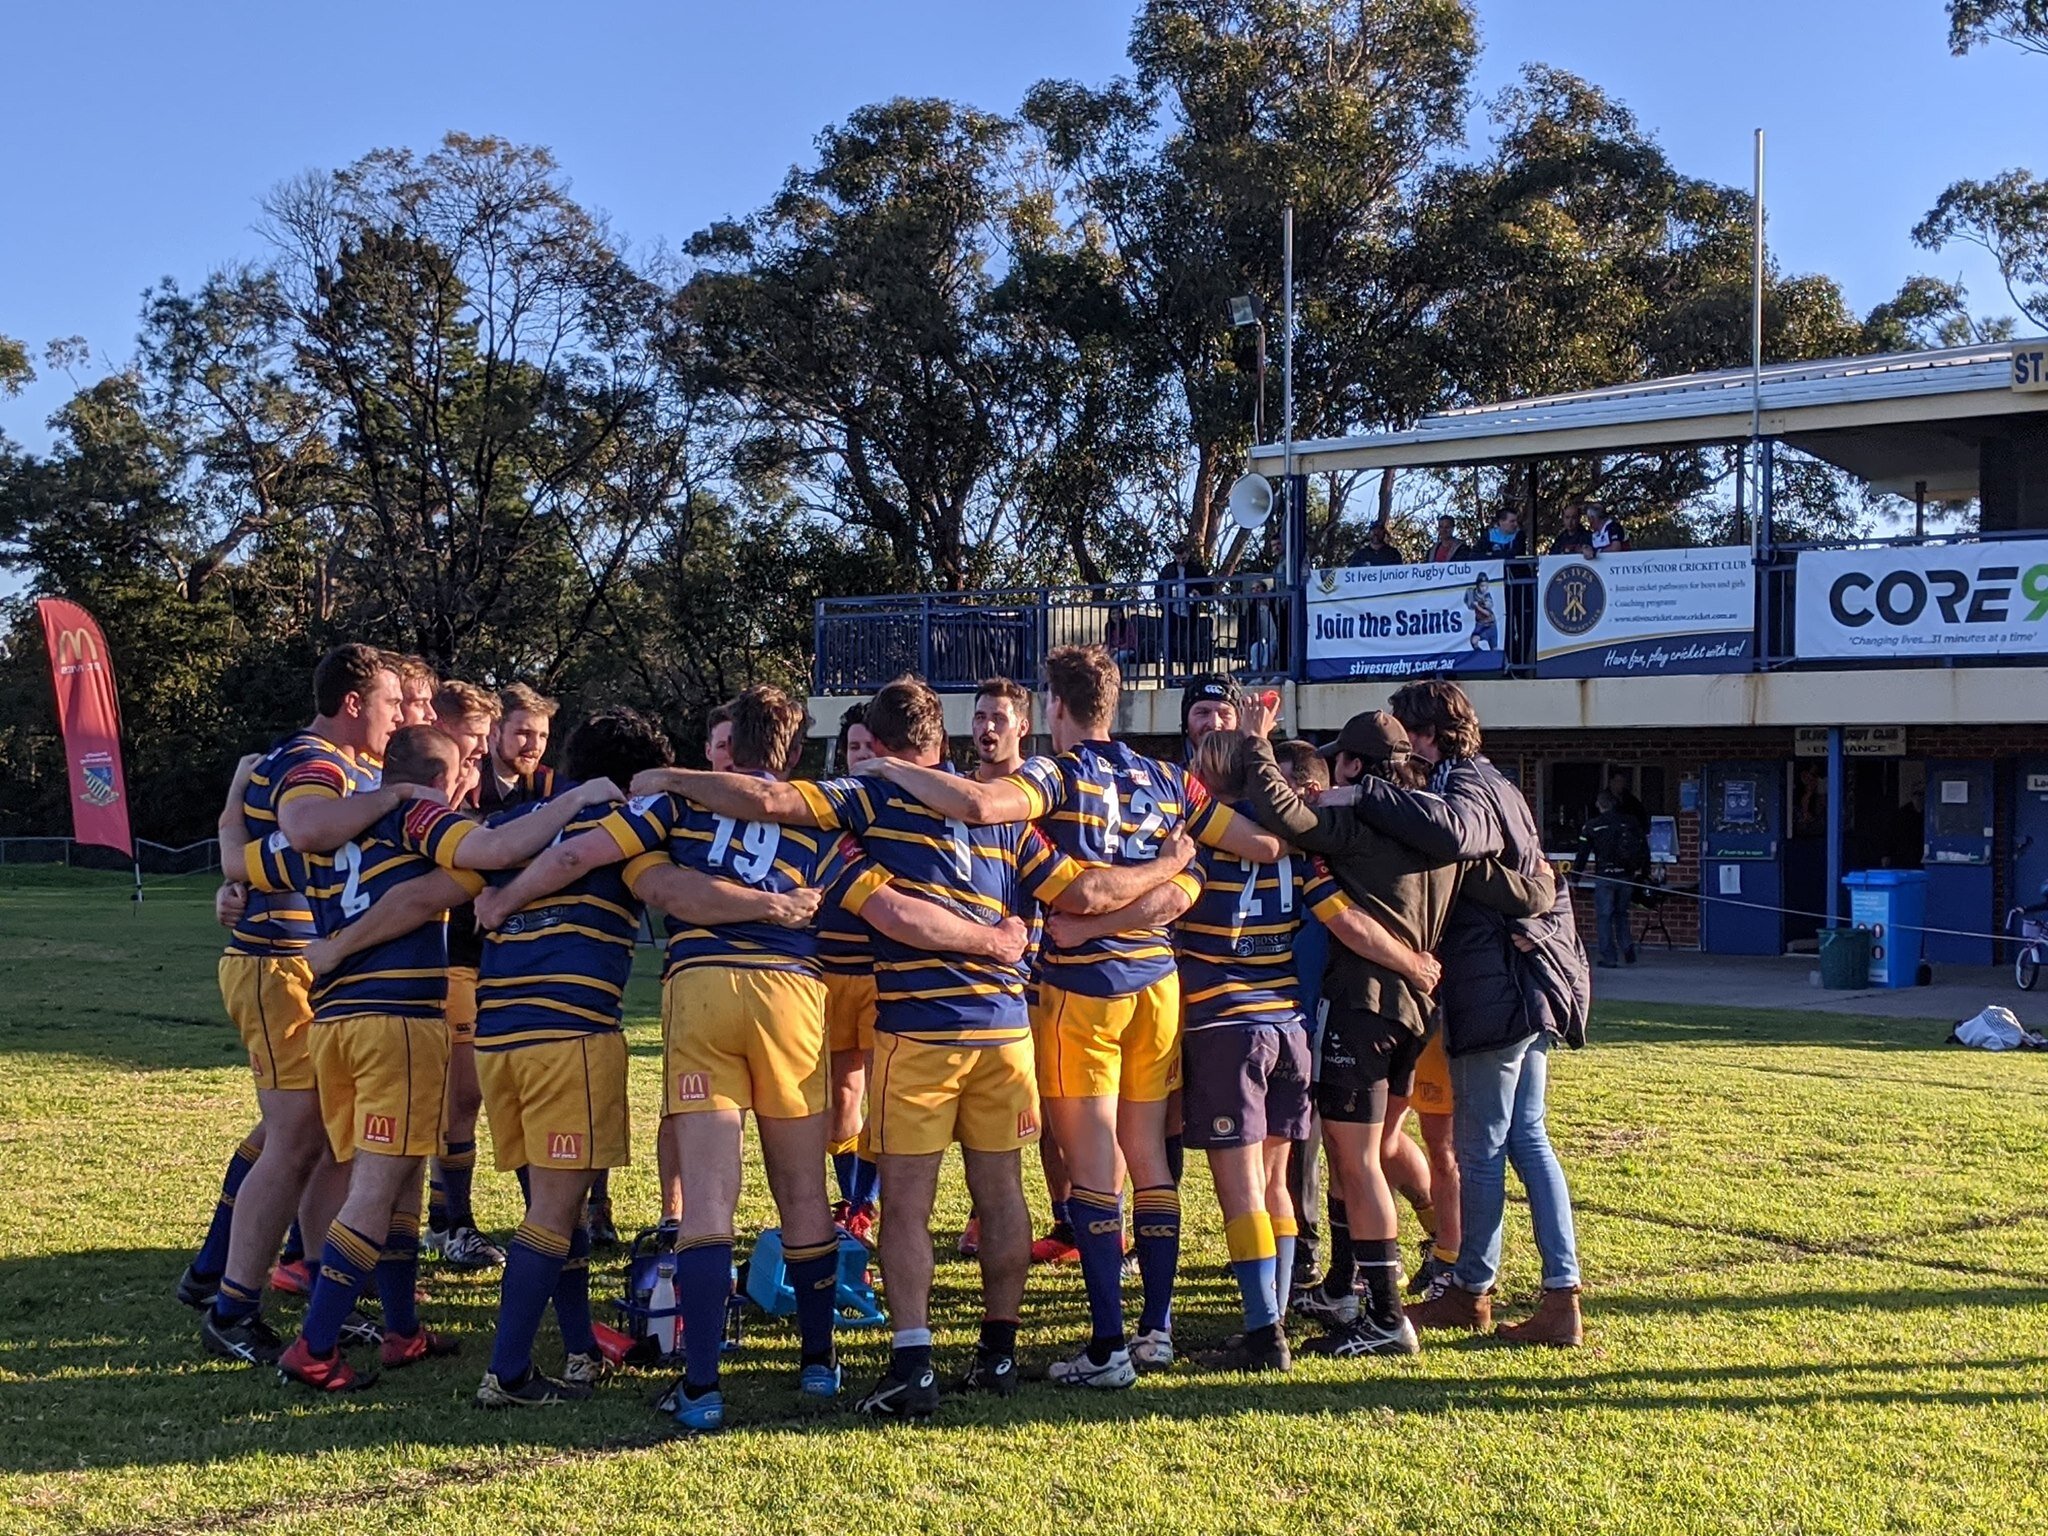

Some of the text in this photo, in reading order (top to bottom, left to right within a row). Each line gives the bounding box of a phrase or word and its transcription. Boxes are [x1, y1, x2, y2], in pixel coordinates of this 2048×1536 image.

[1345, 563, 1471, 583] St Ives Junior Rugby Club
[1610, 560, 1747, 575] ST IVES JUNIOR CRICKET CLUB
[1636, 583, 1657, 591] cricket
[1690, 581, 1699, 589] for
[1717, 580, 1730, 588] and
[1731, 579, 1746, 590] girls
[1615, 599, 1645, 608] Coaching
[1315, 608, 1463, 640] Join the Saints
[1943, 633, 1986, 643] minutes
[1988, 633, 1998, 642] at
[1604, 650, 1628, 667] Have
[1646, 646, 1669, 668] play
[1670, 643, 1706, 660] cricket
[1705, 642, 1727, 658] with
[1350, 659, 1456, 675] stivesrugby.com.au
[1813, 745, 1886, 753] ENANCE
[1102, 782, 1166, 860] 12
[708, 812, 782, 885] 19
[944, 815, 972, 882] 1
[333, 841, 371, 919] 2
